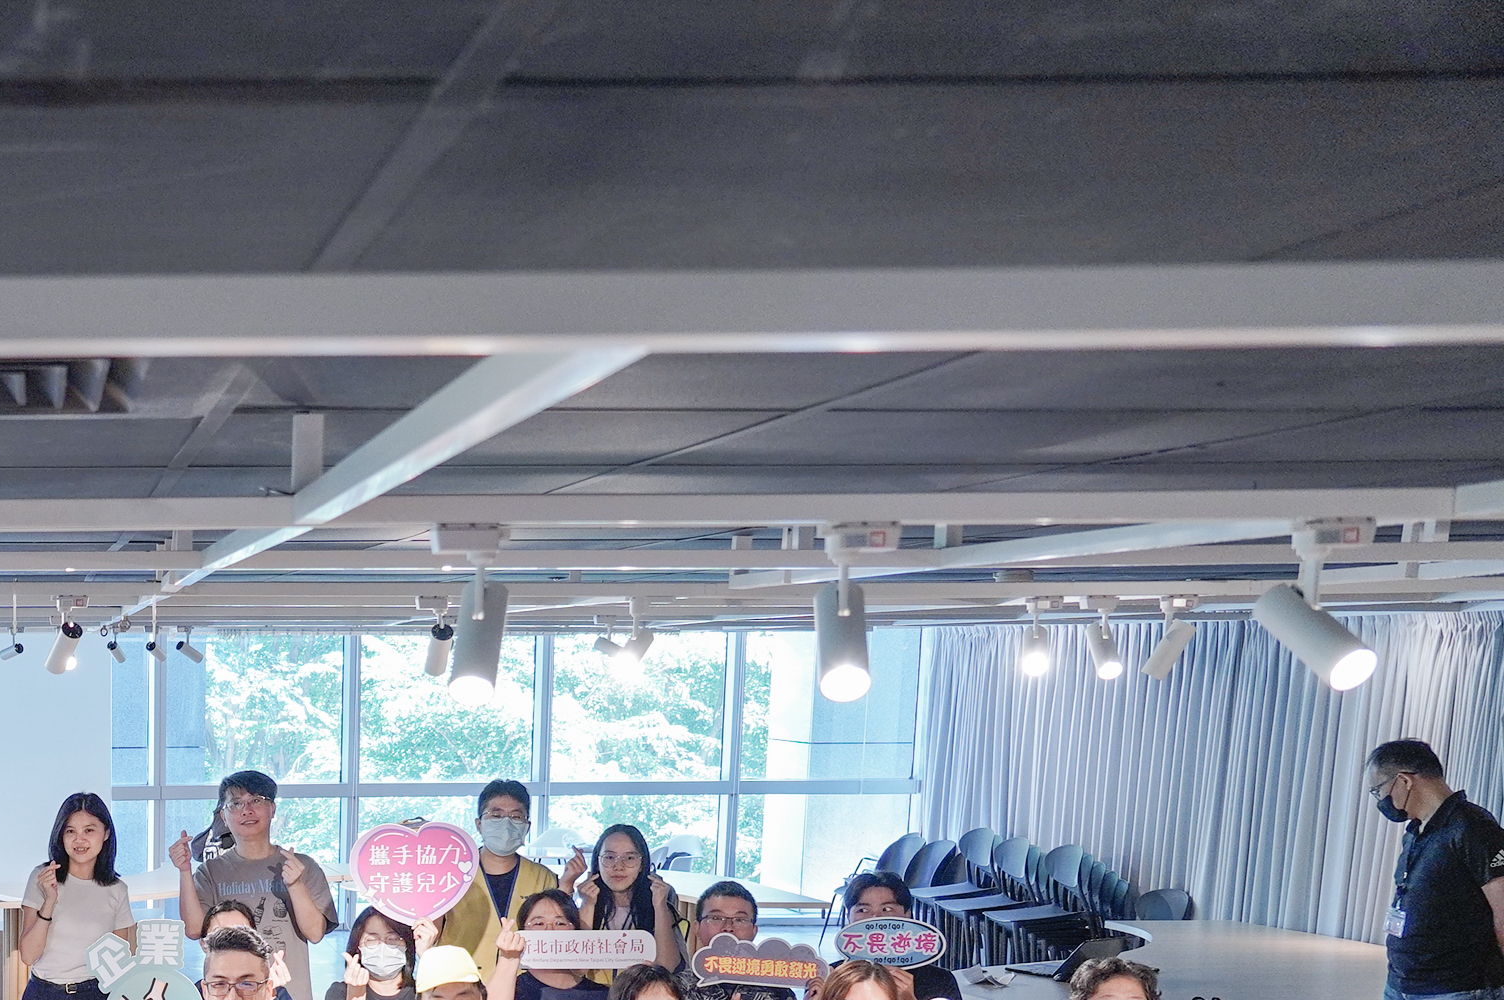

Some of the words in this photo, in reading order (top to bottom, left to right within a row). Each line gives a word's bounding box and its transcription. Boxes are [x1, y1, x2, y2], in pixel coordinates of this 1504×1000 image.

[368, 844, 460, 866] 攜手協力
[218, 881, 256, 898] Holiday
[369, 872, 461, 894] 守護兒少
[842, 932, 937, 954] 不畏逆境
[88, 922, 180, 989] 企業
[704, 955, 817, 979] 不畏逆境勇敢發光
